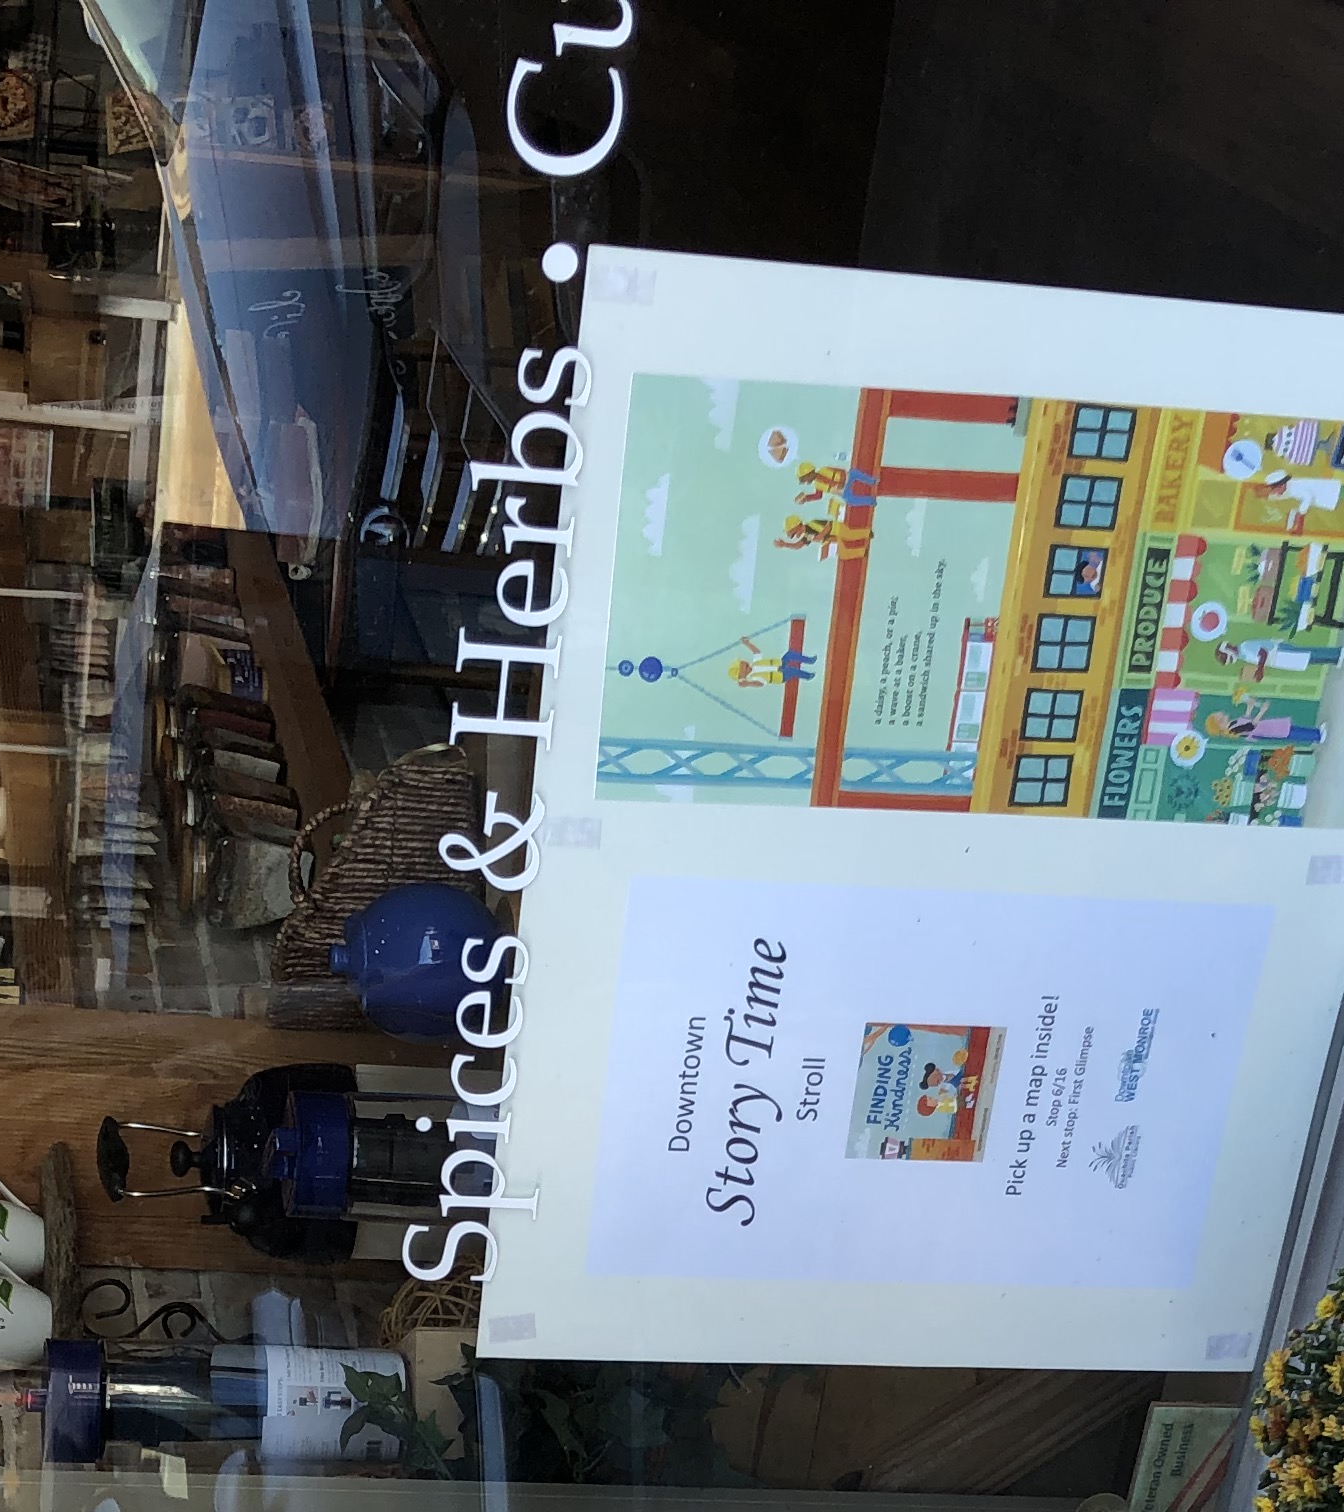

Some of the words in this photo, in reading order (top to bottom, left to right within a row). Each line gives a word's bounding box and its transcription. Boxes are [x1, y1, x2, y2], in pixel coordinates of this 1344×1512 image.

[1154, 412, 1195, 524] BAKERY
[448, 346, 593, 750] Herbs
[929, 602, 939, 612] in
[931, 582, 942, 599] the
[1130, 555, 1169, 667] PRODUCE
[929, 615, 939, 629] up
[922, 632, 936, 667] shared
[916, 670, 930, 718] sandwich
[1102, 703, 1145, 808] FLOWERS
[437, 789, 547, 892] &
[724, 937, 788, 1067] Time
[1029, 994, 1060, 1059] inside!
[1073, 1026, 1095, 1076] Glimpse
[1132, 1008, 1154, 1064] MONROE
[667, 1015, 707, 1152] Downtown
[793, 1056, 827, 1122] Stroll
[866, 1053, 895, 1125] FINDING
[884, 1046, 913, 1133] Kindness
[1024, 1064, 1048, 1107] map
[1050, 1067, 1068, 1097] 6/16
[1068, 1078, 1084, 1105] First
[1124, 1067, 1141, 1103] WEST
[400, 933, 541, 1283] Spices
[1023, 1113, 1037, 1124] a
[1045, 1099, 1063, 1127] Stop
[1062, 1107, 1079, 1138] stop:
[705, 1082, 784, 1227] Story
[1017, 1129, 1036, 1153] up
[1055, 1140, 1073, 1168] Next
[1004, 1159, 1028, 1196] Pick
[1153, 1422, 1173, 1468] Owned
[1169, 1422, 1194, 1477] Business
